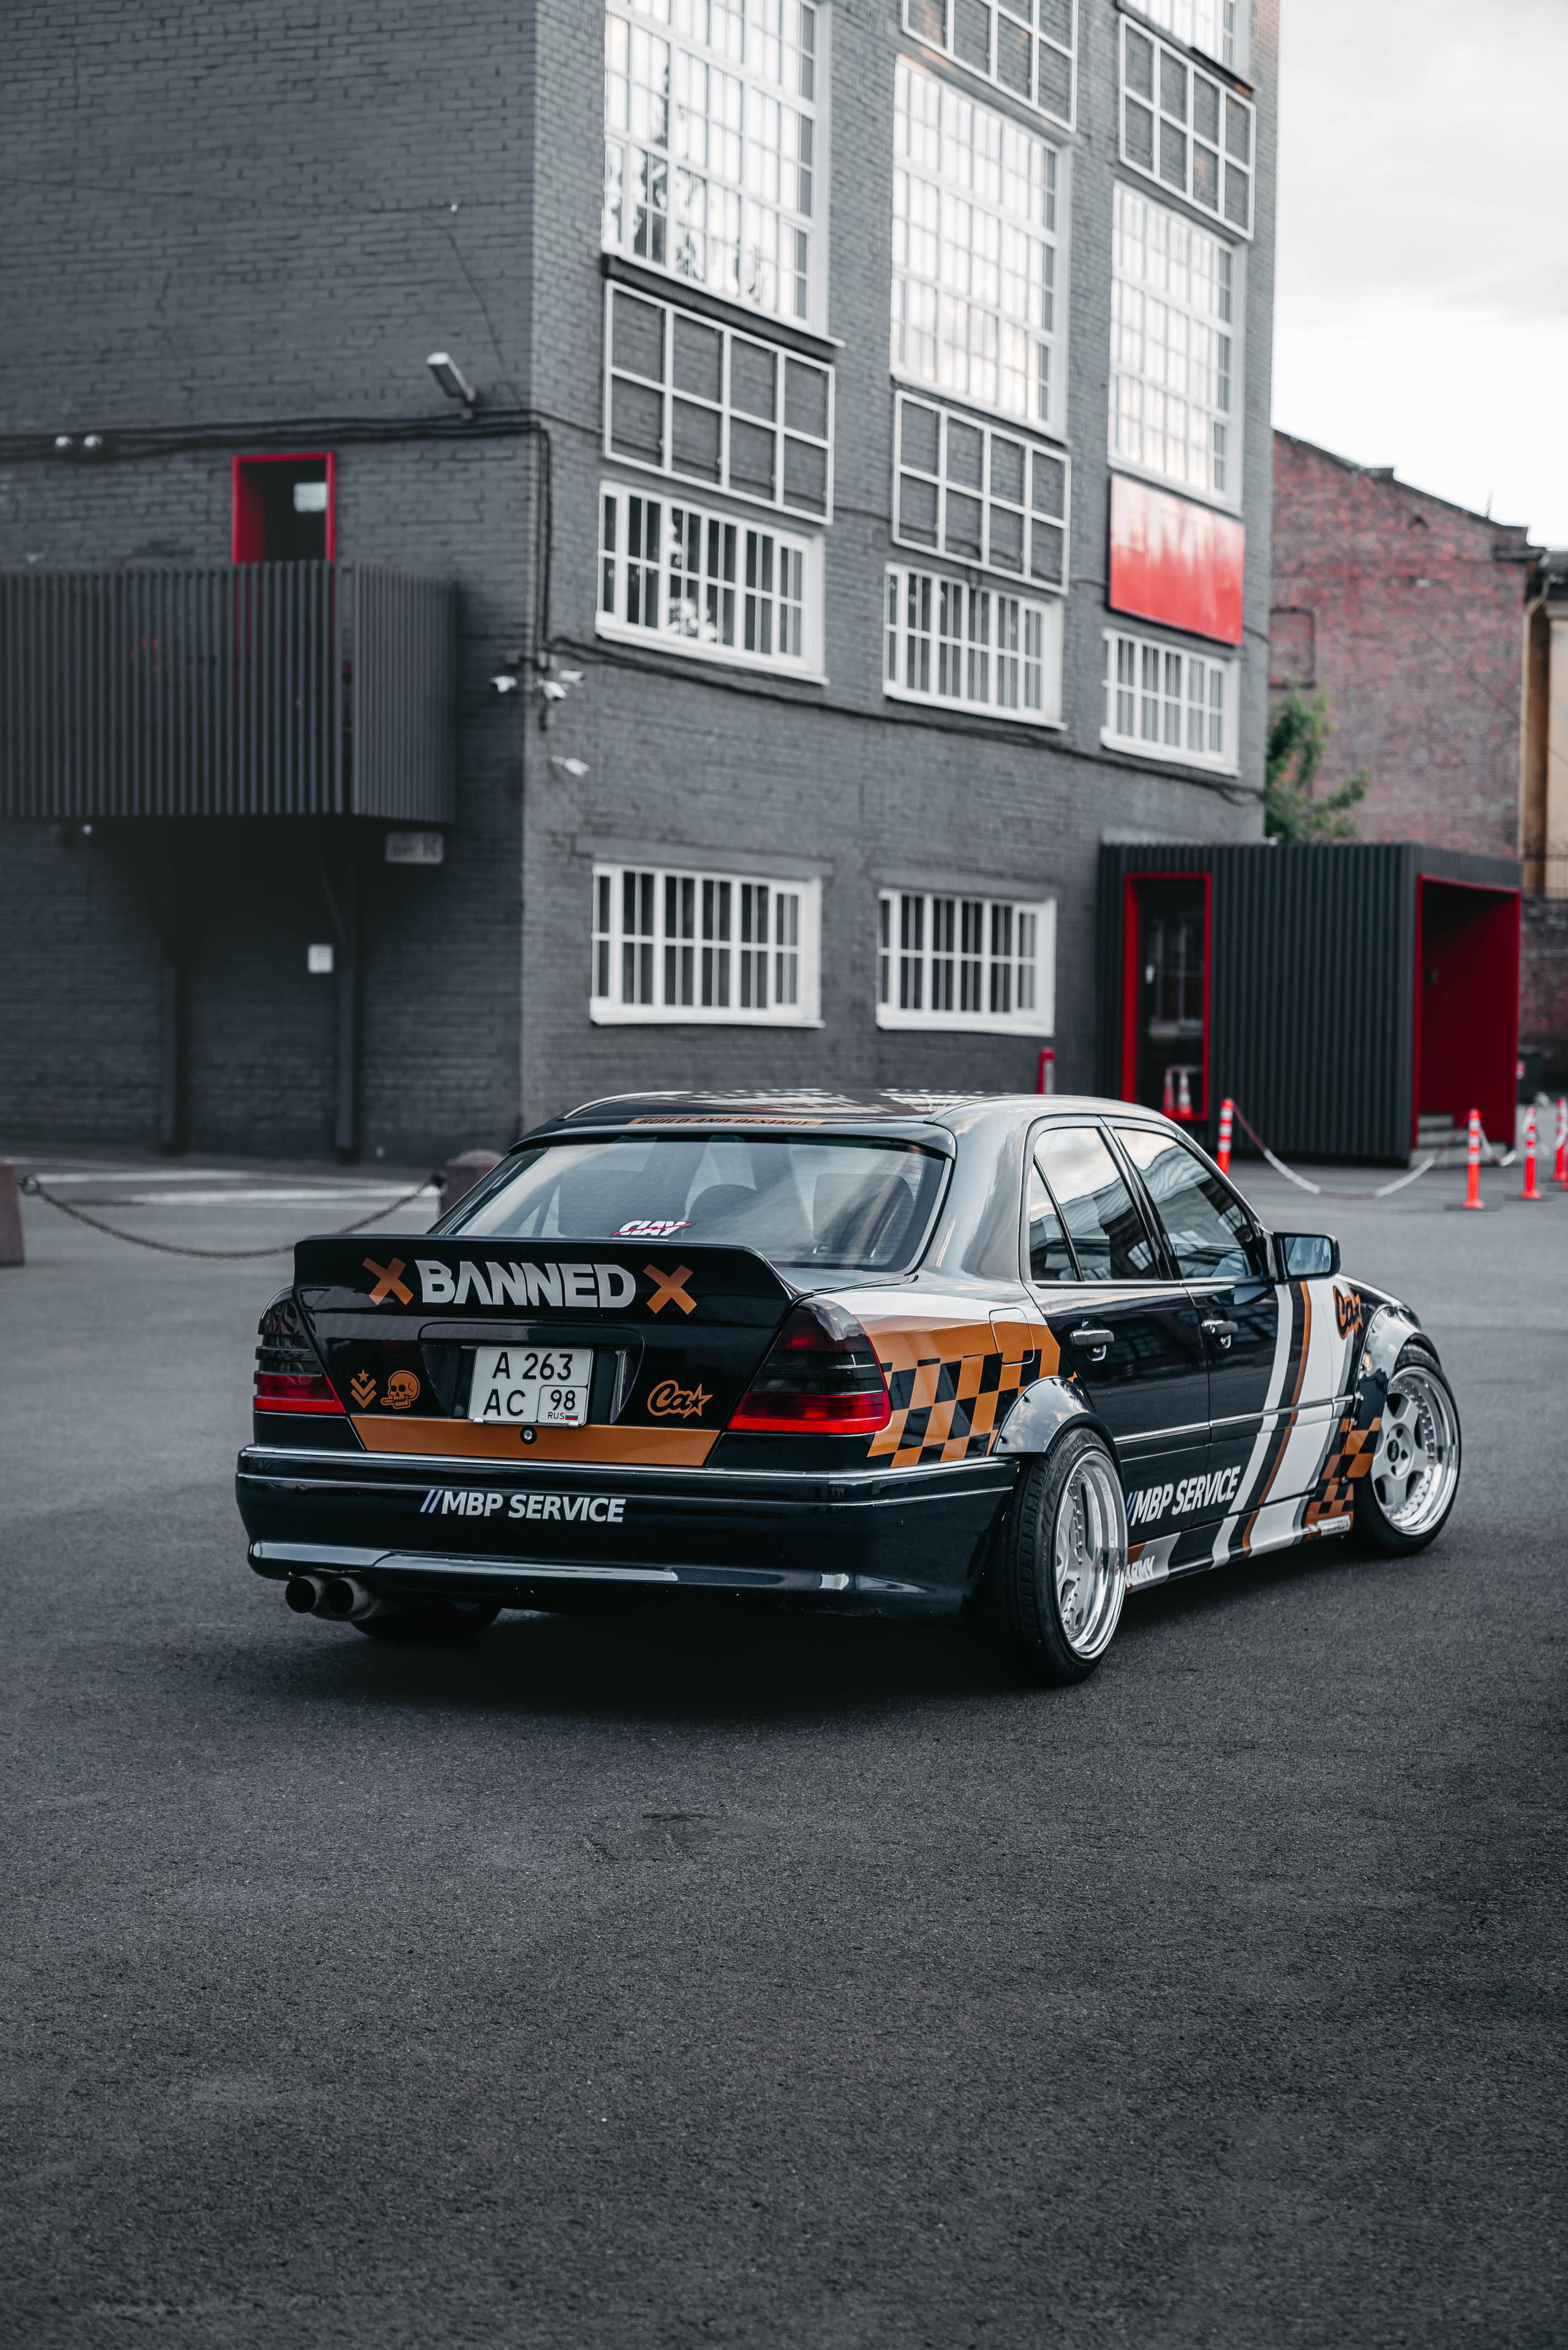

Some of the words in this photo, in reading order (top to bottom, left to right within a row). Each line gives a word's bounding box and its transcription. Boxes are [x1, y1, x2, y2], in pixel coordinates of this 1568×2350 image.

[415, 1260, 636, 1308] BANNED
[492, 1351, 511, 1379] A
[522, 1352, 573, 1380] 263
[483, 1388, 526, 1417] AC
[551, 1389, 576, 1410] 98
[1170, 1465, 1242, 1516] SERVICE
[508, 1494, 627, 1523] SERVICE
